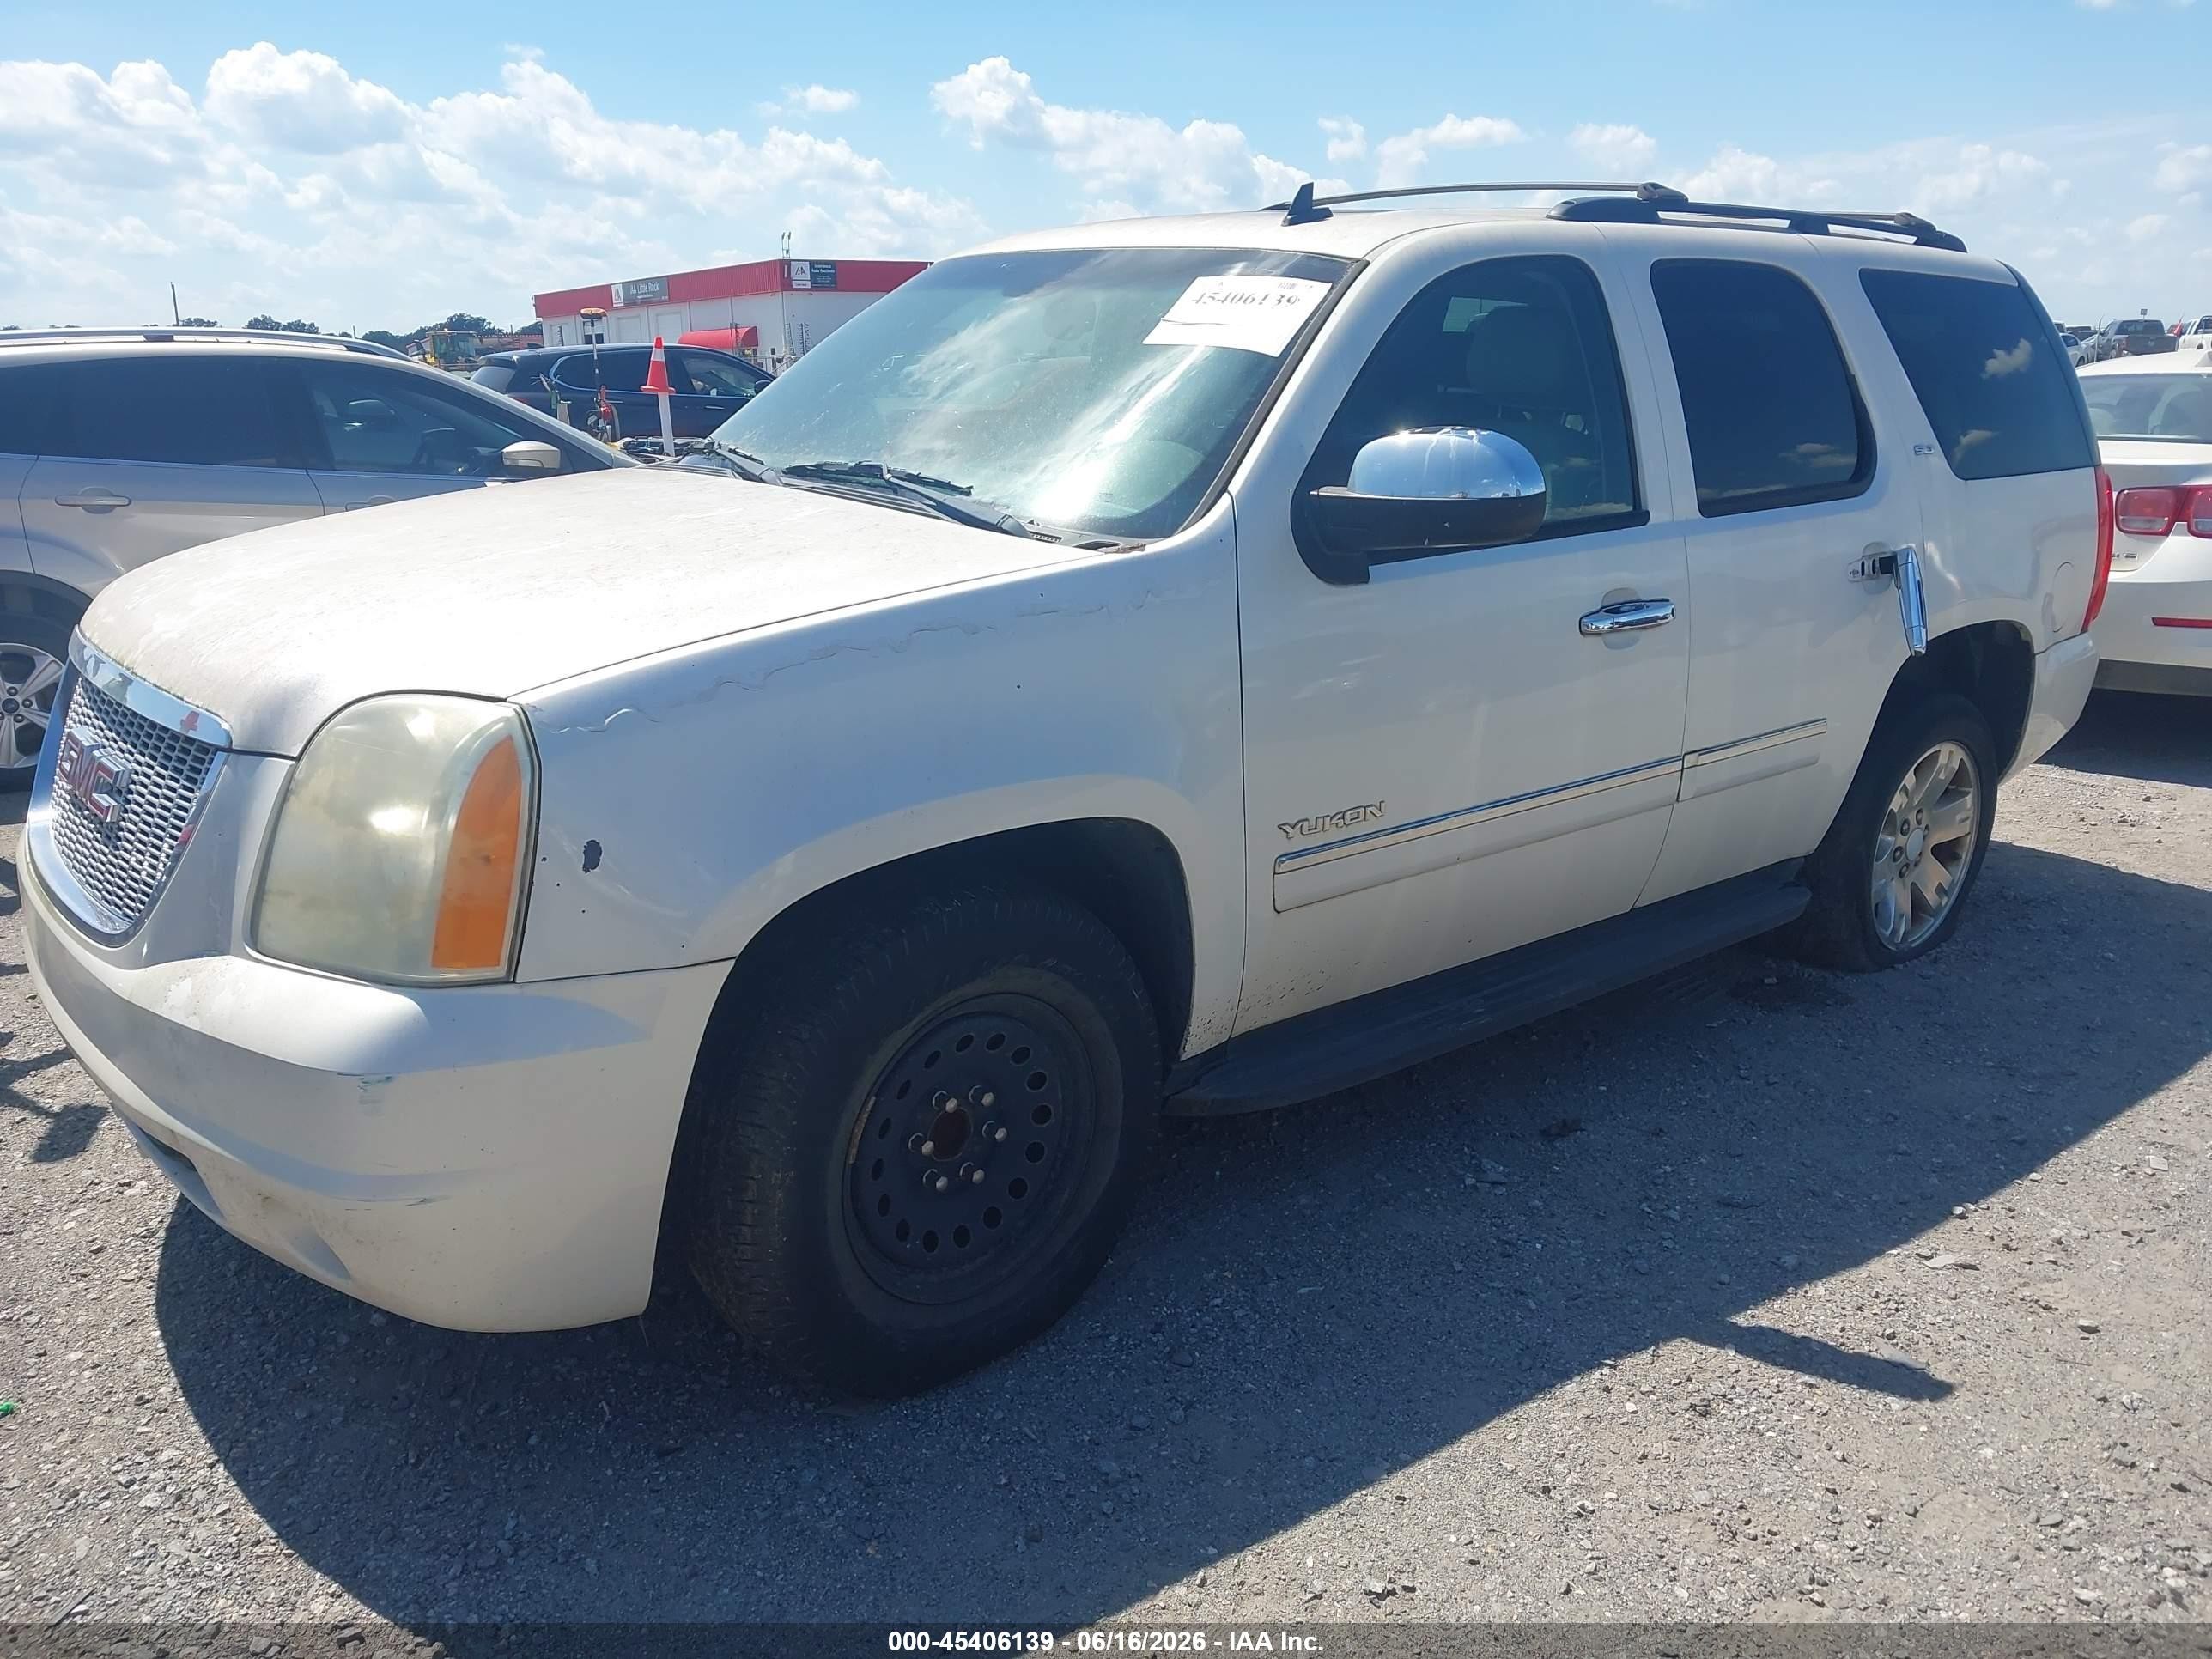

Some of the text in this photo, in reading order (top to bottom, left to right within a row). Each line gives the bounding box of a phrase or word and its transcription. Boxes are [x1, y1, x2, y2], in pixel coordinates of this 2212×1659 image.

[1191, 291, 1300, 307] 45406139
[58, 726, 133, 823] GMC
[1278, 800, 1385, 839] YUKON
